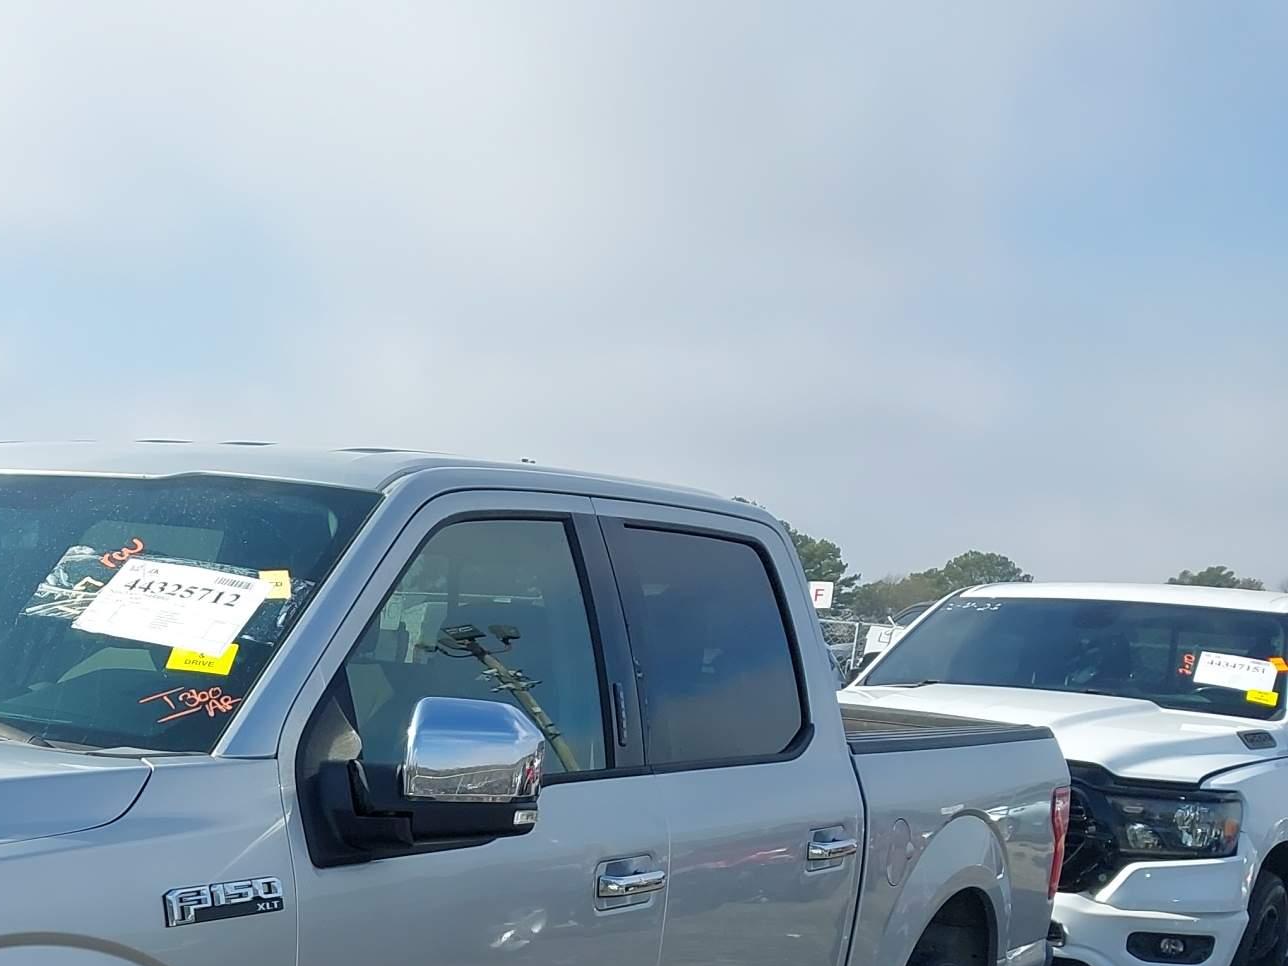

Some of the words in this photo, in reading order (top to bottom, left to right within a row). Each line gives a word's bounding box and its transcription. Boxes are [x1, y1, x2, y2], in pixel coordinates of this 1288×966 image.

[123, 577, 242, 608] 44325712
[813, 588, 825, 602] F
[183, 658, 216, 668] DRIVE
[256, 900, 281, 912] XLT
